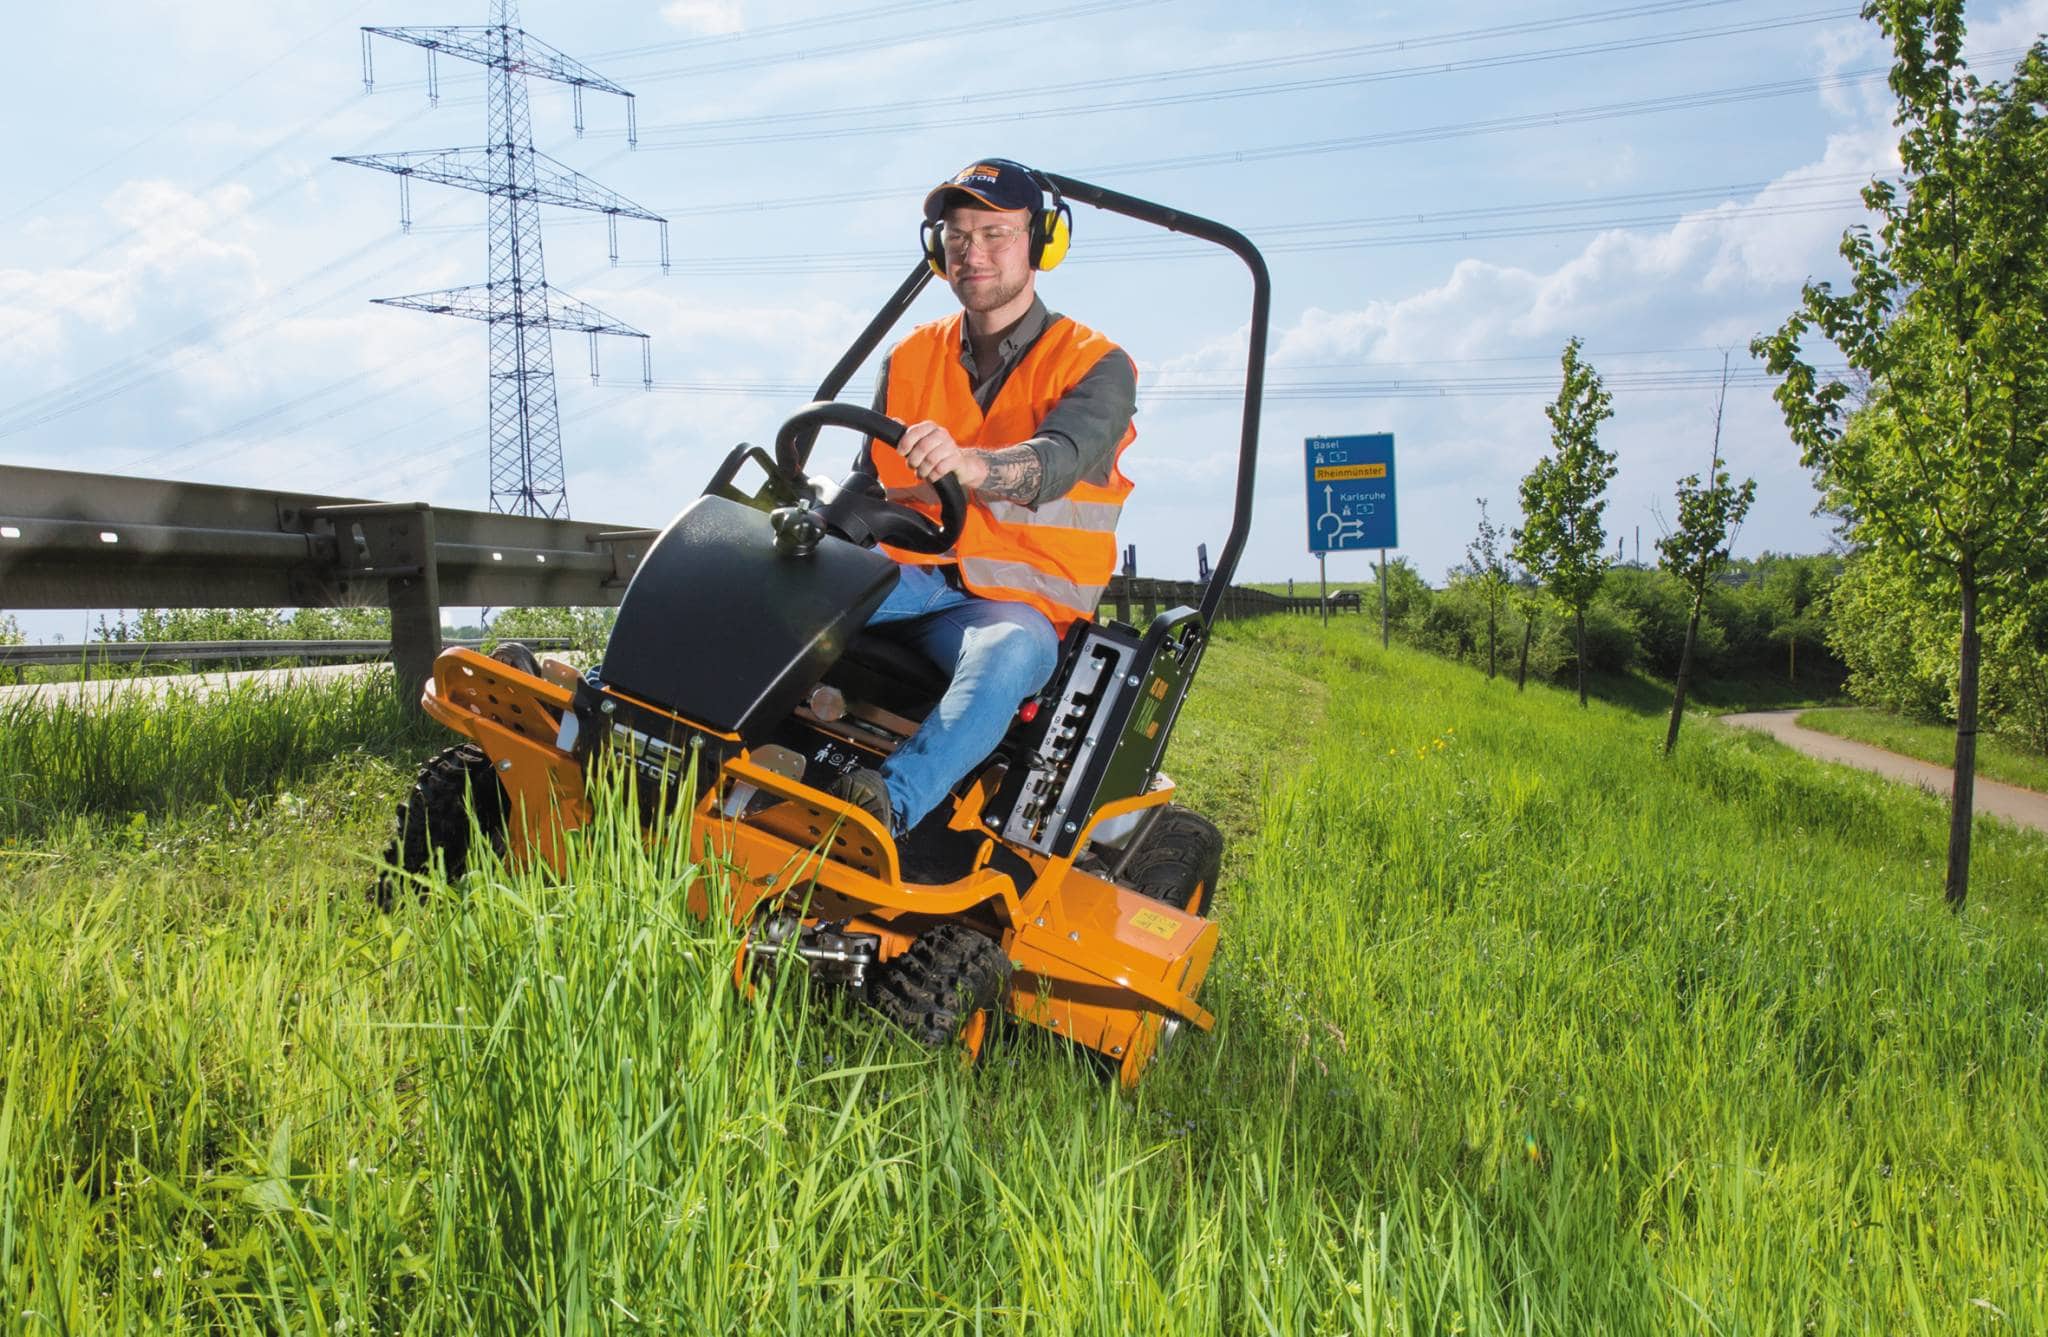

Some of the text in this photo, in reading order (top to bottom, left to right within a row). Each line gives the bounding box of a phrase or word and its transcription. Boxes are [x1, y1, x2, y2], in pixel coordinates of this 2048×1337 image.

[1313, 440, 1339, 449] Basel
[1317, 466, 1383, 479] Rheinmünster
[1340, 492, 1386, 501] Karlsruhe
